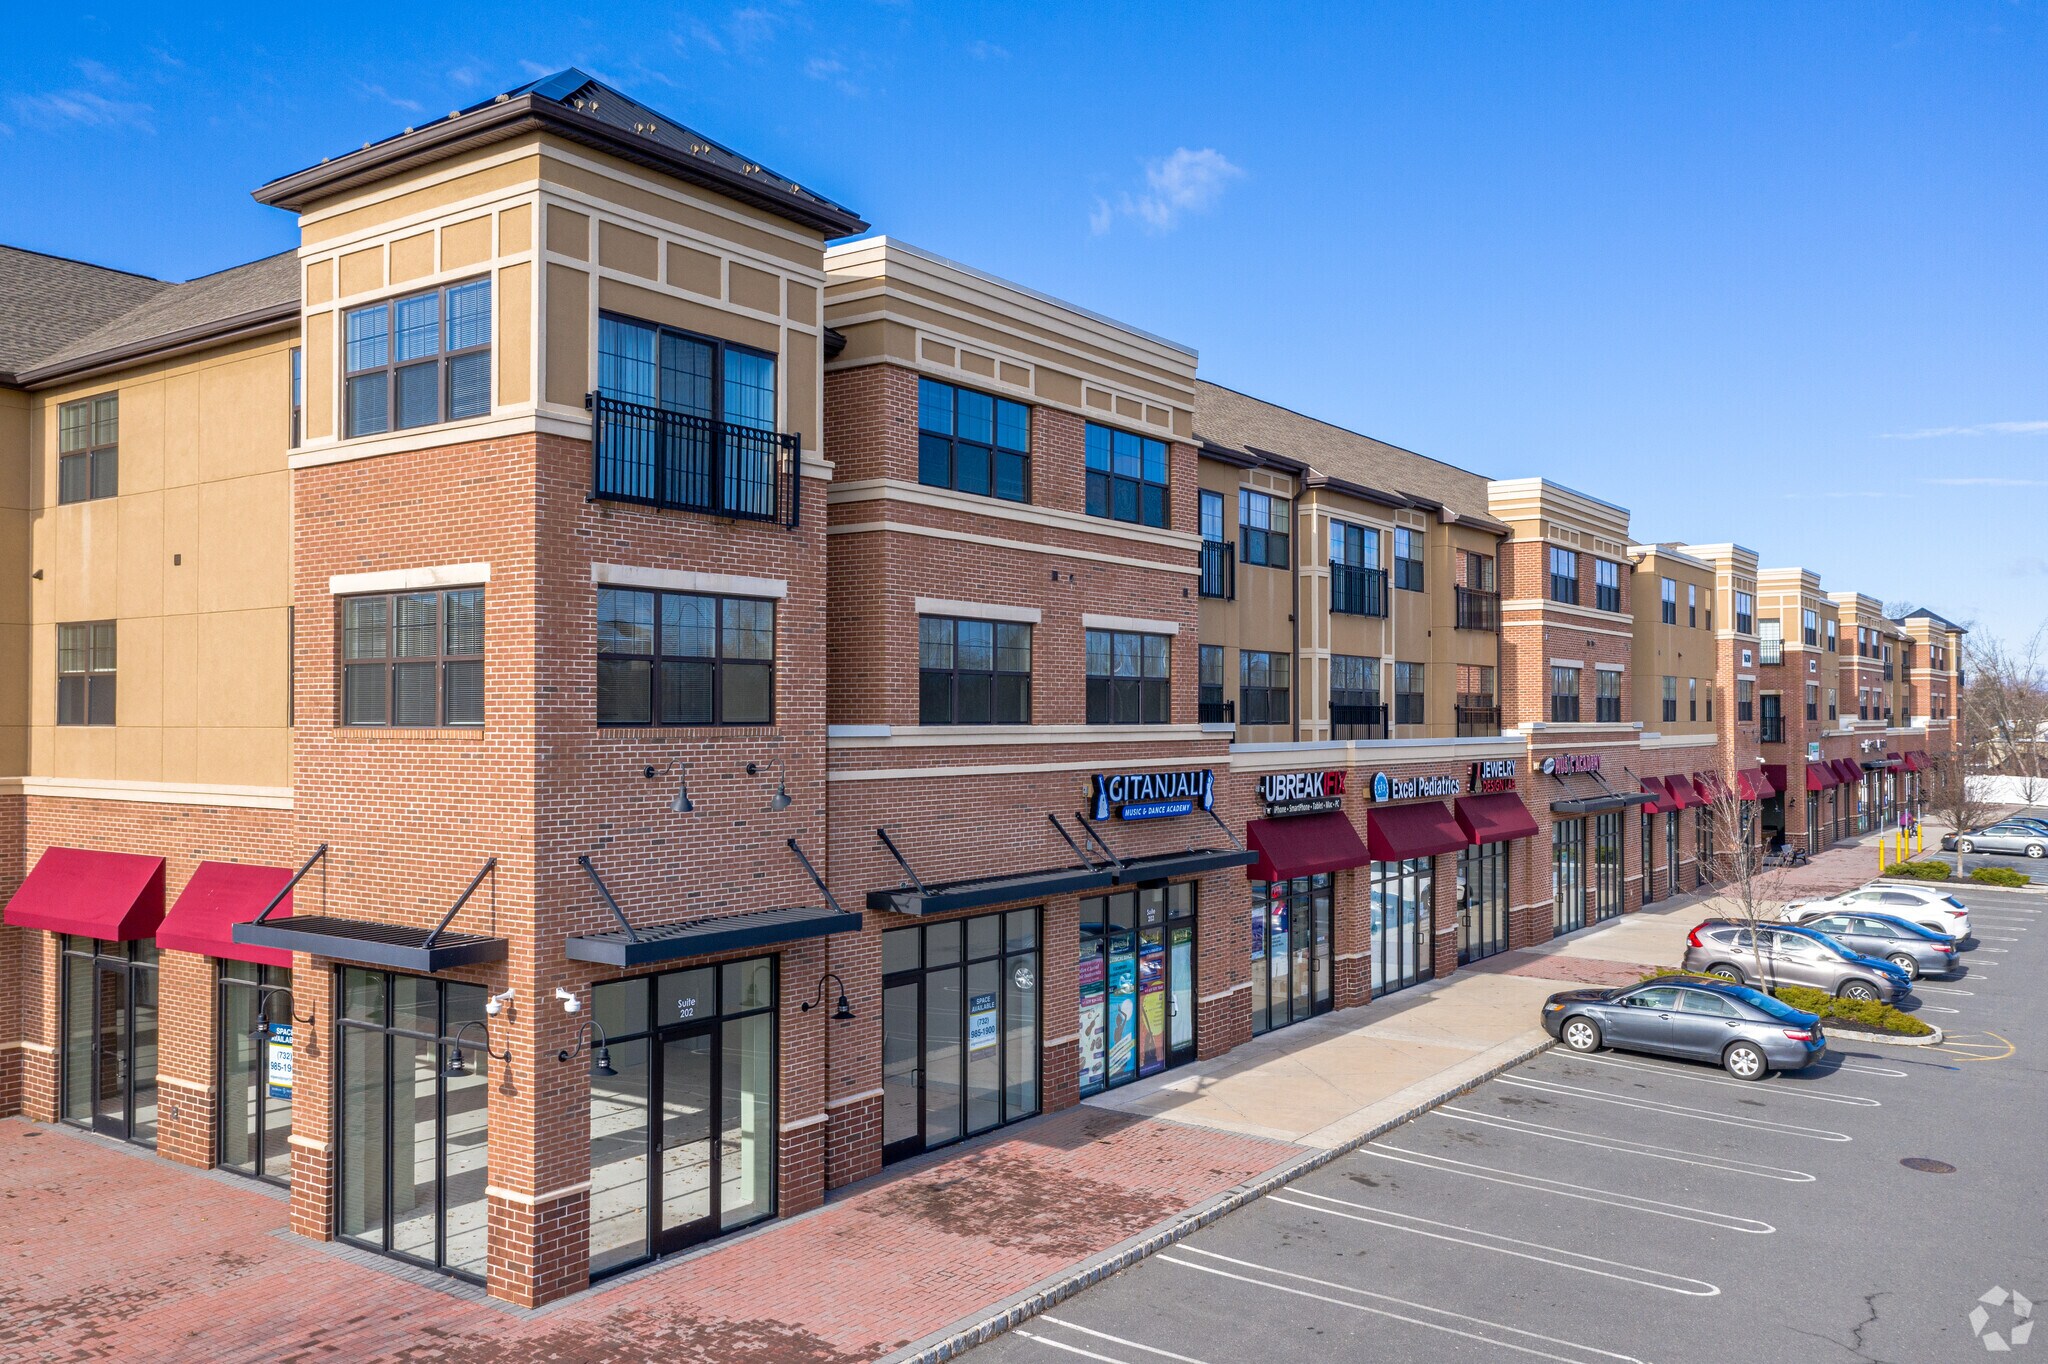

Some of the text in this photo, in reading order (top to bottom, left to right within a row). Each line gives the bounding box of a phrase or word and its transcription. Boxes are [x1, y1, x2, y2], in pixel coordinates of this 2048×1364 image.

[1482, 760, 1516, 779] JEWELRY
[1109, 772, 1204, 802] GITANJALI
[1265, 771, 1347, 802] UBREAKIFIX
[1392, 775, 1460, 799] Excel Pediatrics
[1483, 778, 1516, 792] DESIGN LAB
[1124, 808, 1141, 817] MUSIC
[1148, 805, 1166, 815] DANCE
[1166, 803, 1190, 813] ACADEMY
[677, 997, 696, 1009] Suite
[976, 996, 991, 1004] SPACE
[972, 1001, 995, 1012] AVAILABLE
[680, 1007, 694, 1019] 202
[977, 1017, 989, 1027] (732)
[276, 1027, 292, 1036] SPAC
[971, 1025, 995, 1038] 985-1900
[277, 1051, 292, 1061] (732)
